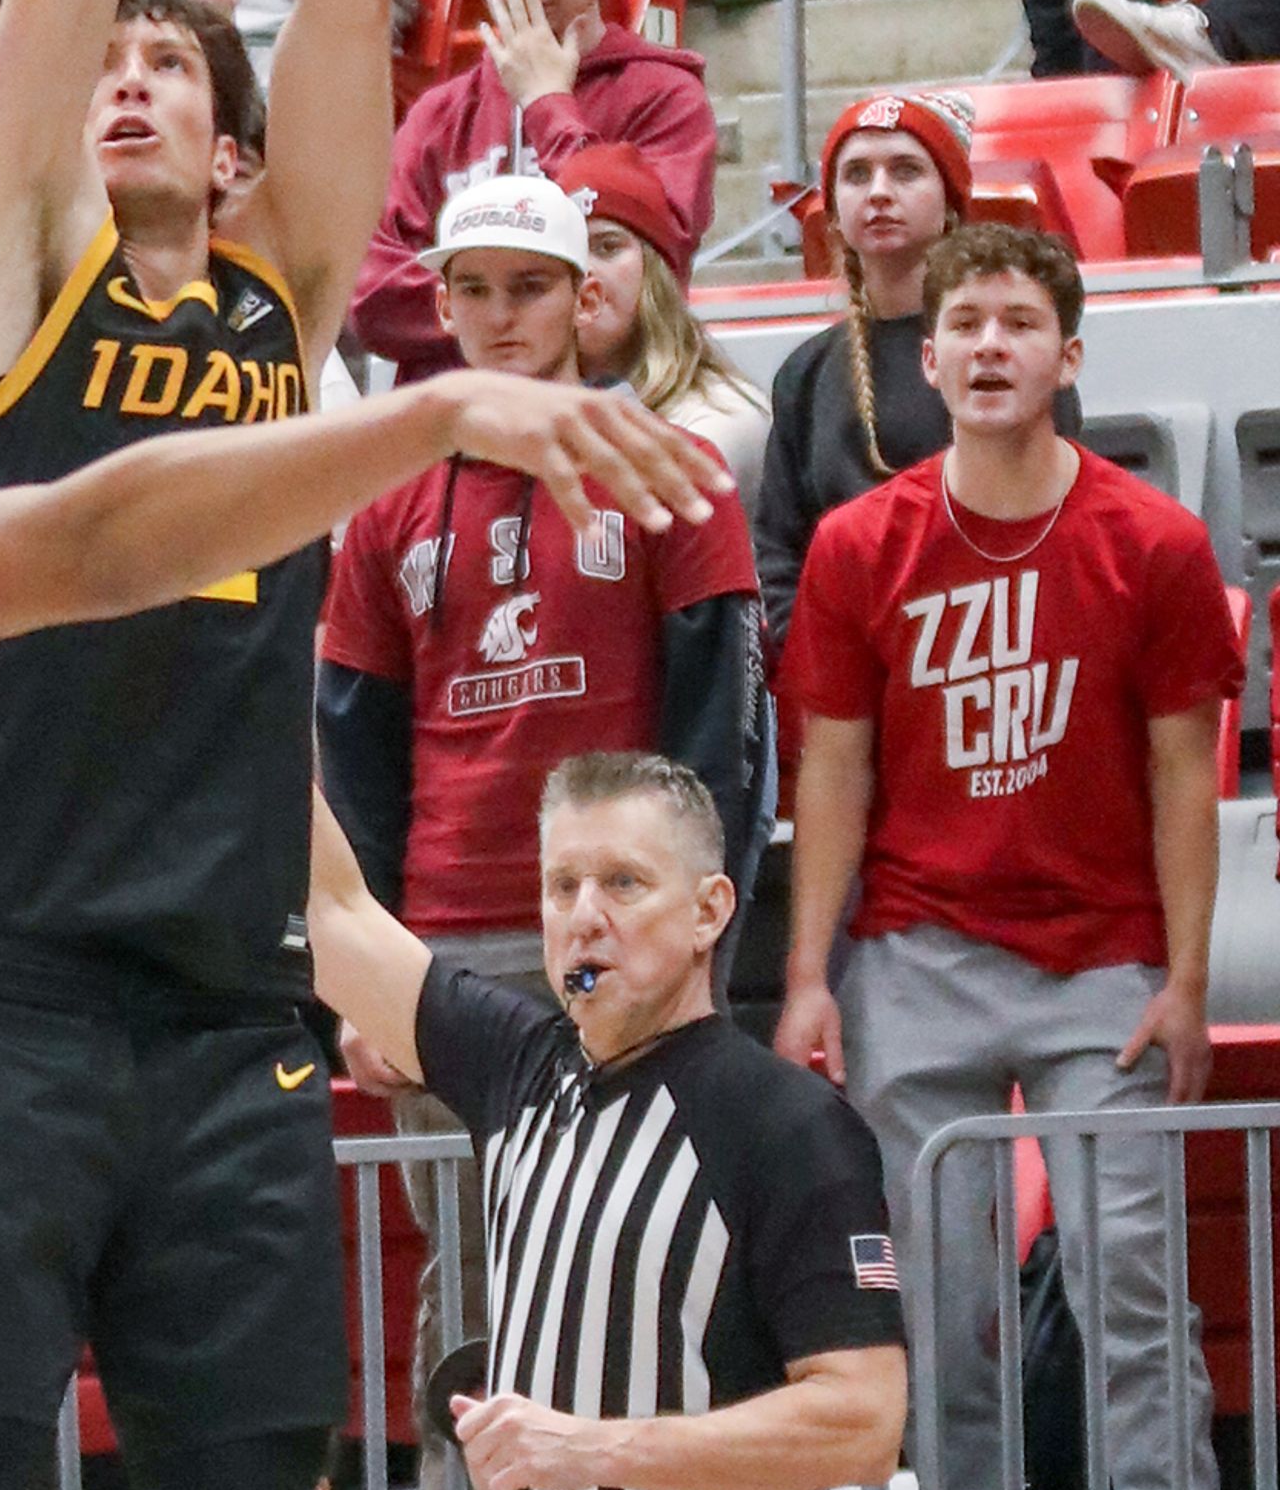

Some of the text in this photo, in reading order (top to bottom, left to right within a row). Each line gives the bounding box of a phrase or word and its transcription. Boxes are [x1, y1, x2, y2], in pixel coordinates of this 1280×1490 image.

[81, 338, 303, 425] IDAHO
[902, 569, 1039, 690] ZZU
[942, 657, 1080, 771] CRU
